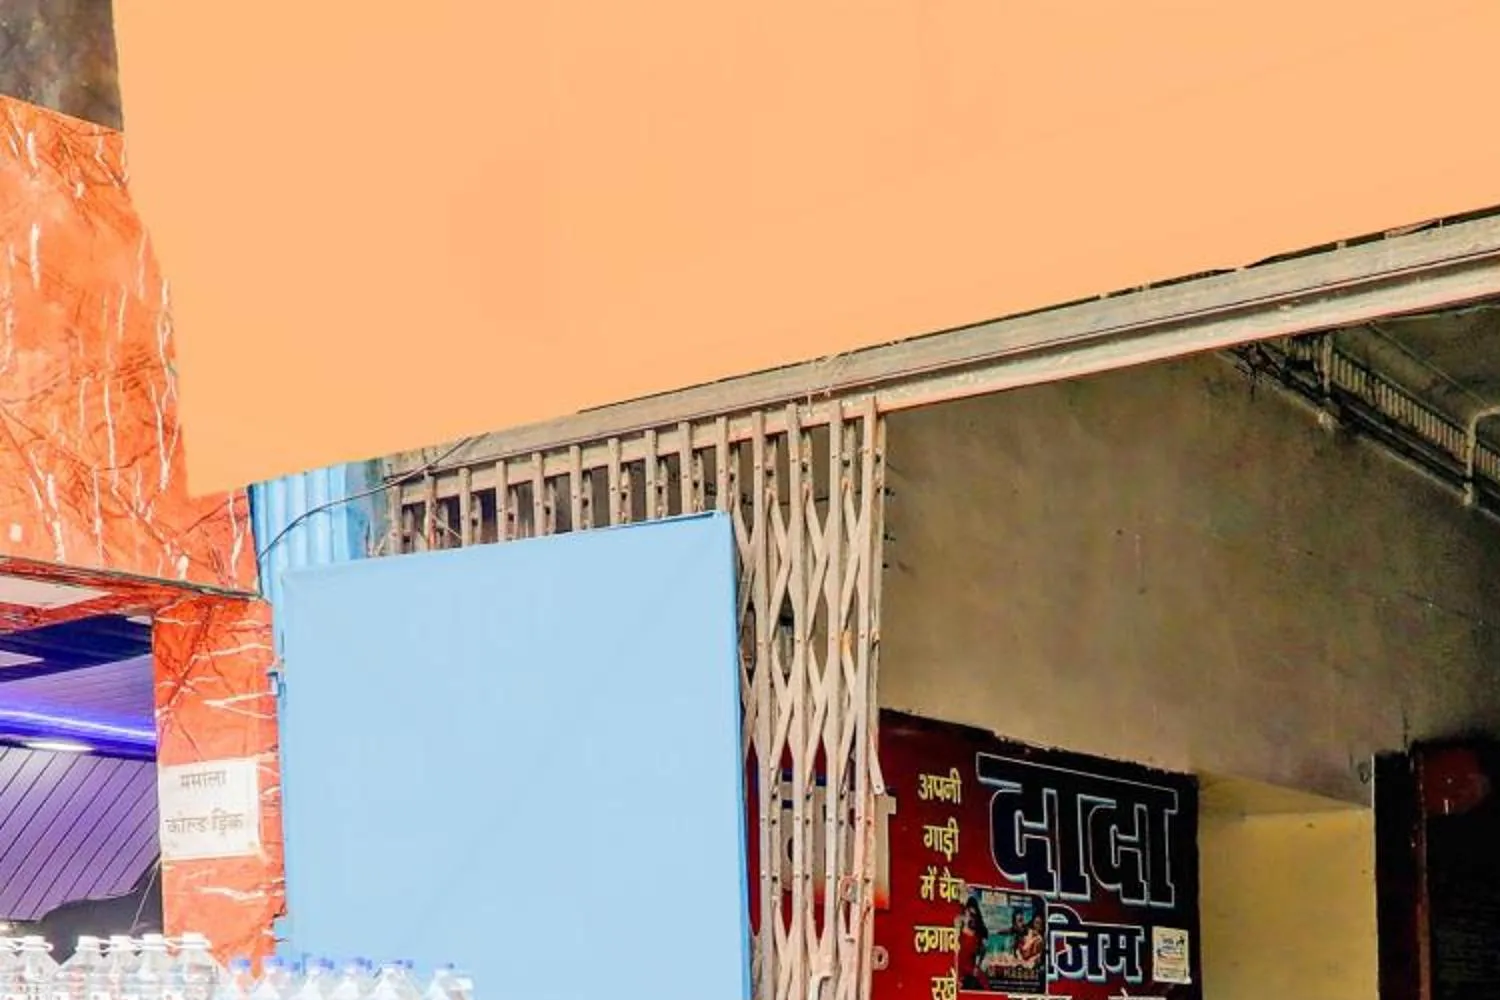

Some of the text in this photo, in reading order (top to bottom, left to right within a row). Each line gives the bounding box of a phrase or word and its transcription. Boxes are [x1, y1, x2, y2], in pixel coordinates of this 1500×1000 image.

[918, 767, 962, 804] अपनी
[975, 751, 1179, 908] दादा
[919, 864, 938, 901] में
